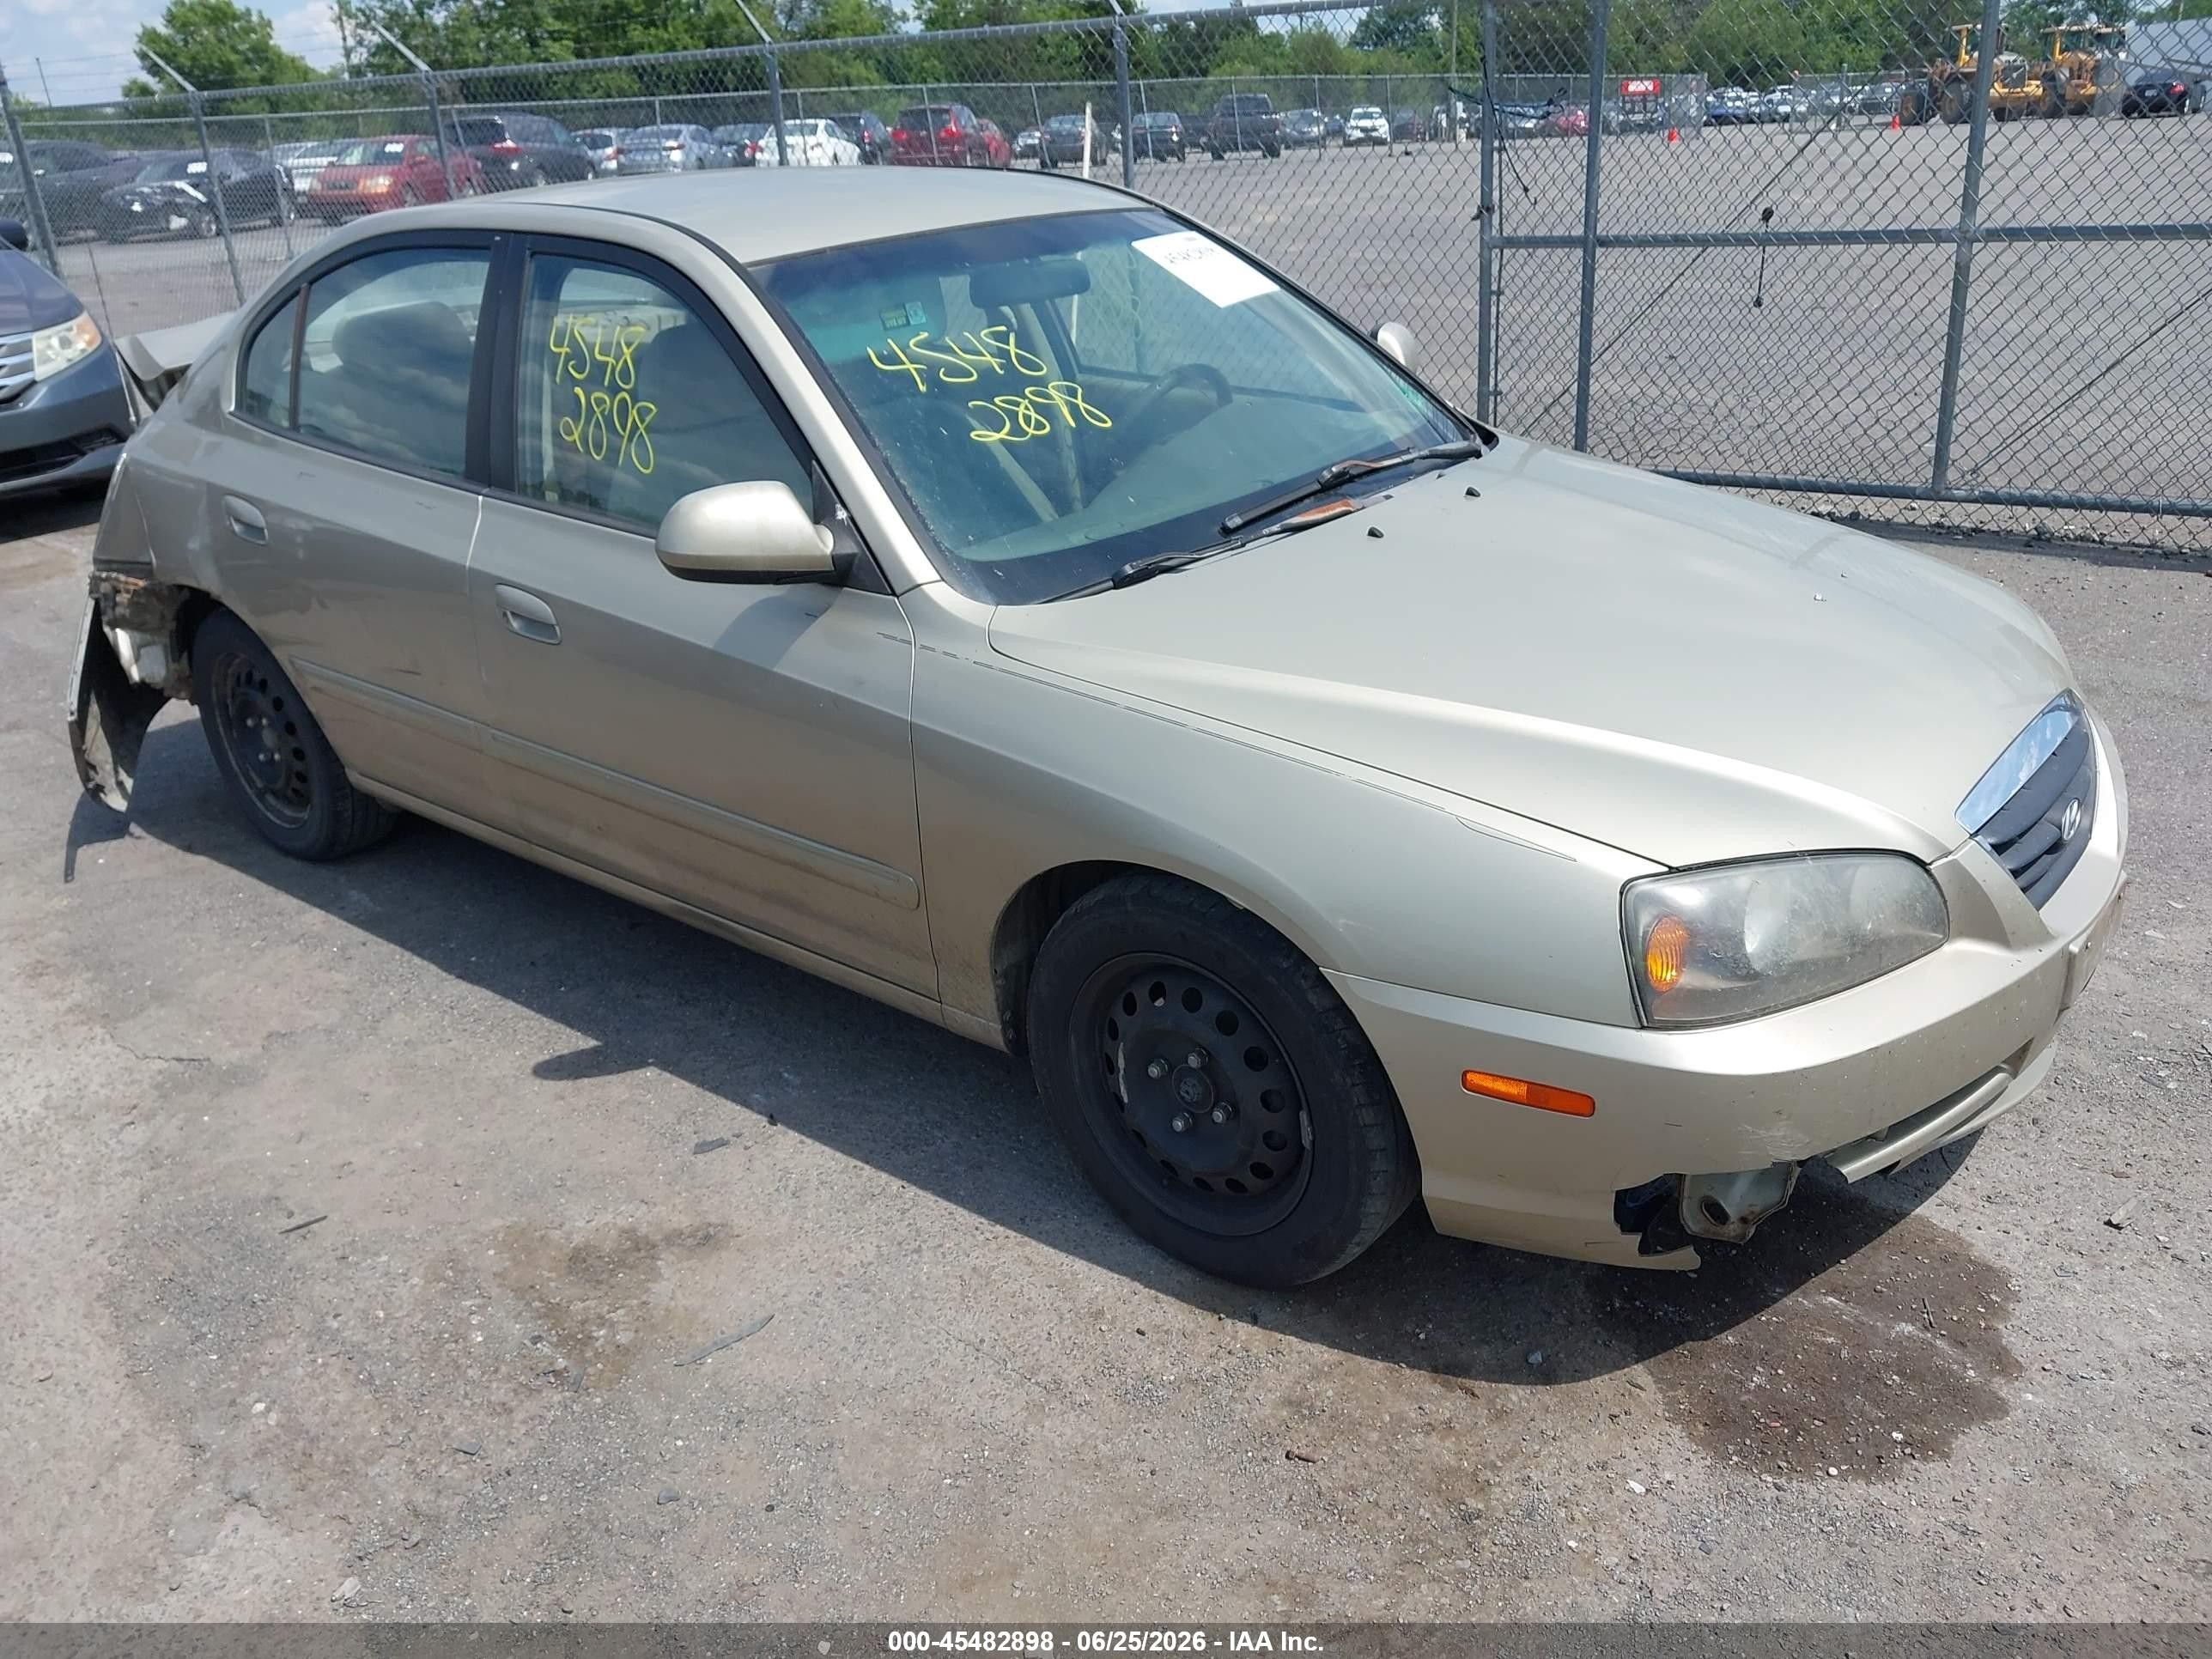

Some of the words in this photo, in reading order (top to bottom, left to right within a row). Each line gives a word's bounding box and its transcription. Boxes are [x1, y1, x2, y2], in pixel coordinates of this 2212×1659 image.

[550, 313, 645, 389] 4548
[866, 325, 1047, 392] 4548
[560, 386, 658, 474] 2898
[968, 381, 1112, 441] 2898
